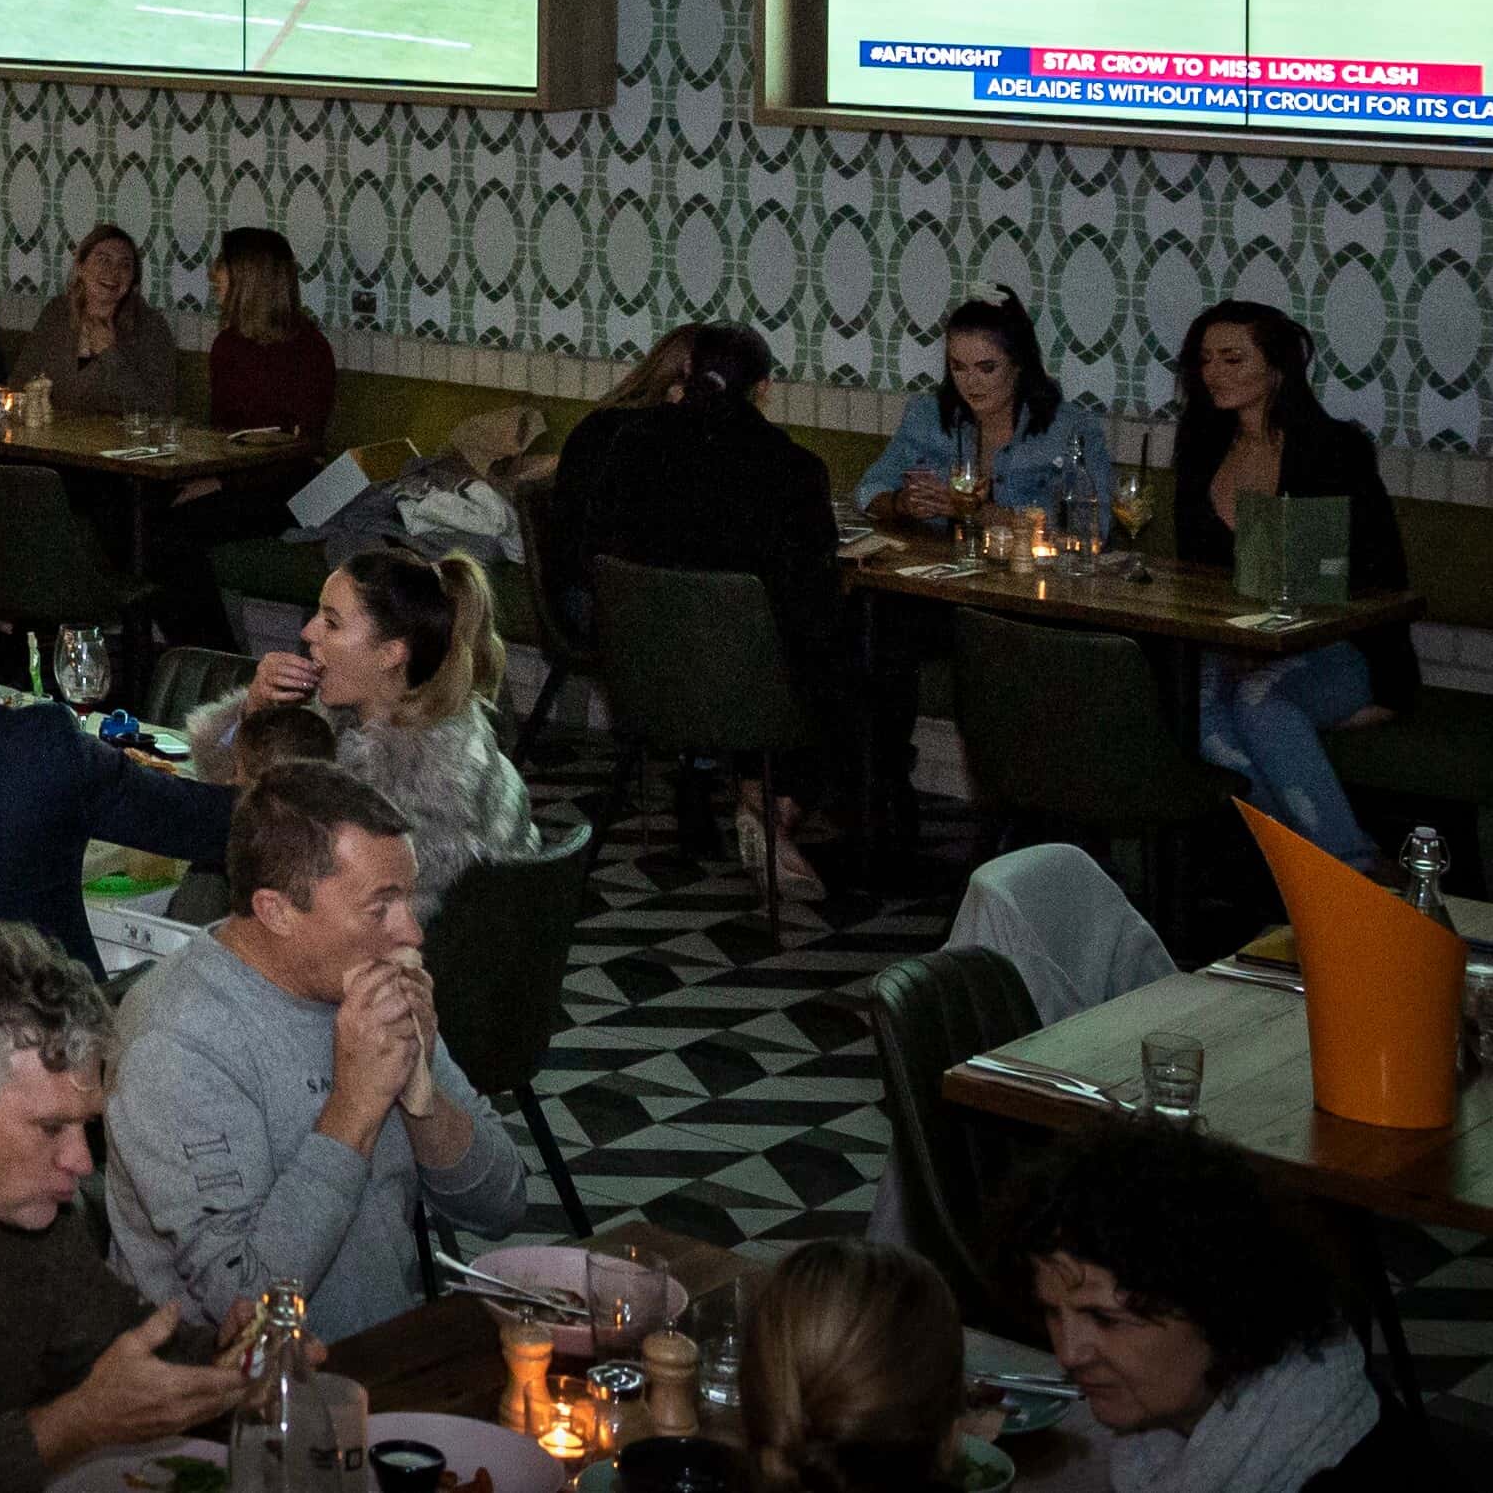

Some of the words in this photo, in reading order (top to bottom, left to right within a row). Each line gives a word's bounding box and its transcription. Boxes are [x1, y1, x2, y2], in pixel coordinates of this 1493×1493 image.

[869, 45, 1002, 68] #AFLTONIGHT
[1043, 51, 1096, 72] STAR
[1101, 54, 1169, 75] CROW
[1172, 57, 1204, 77] TO
[1209, 59, 1262, 79] MISS
[1268, 61, 1336, 83] LIONS
[1341, 64, 1419, 86] CLASH
[987, 77, 1082, 101] ADELAIDE
[1086, 82, 1105, 101] IS
[1108, 83, 1202, 106] WITHOUT
[1205, 88, 1263, 108] MATT
[1265, 91, 1360, 114] CROUCH
[1365, 95, 1411, 117] FOR
[1416, 97, 1448, 118] ITS
